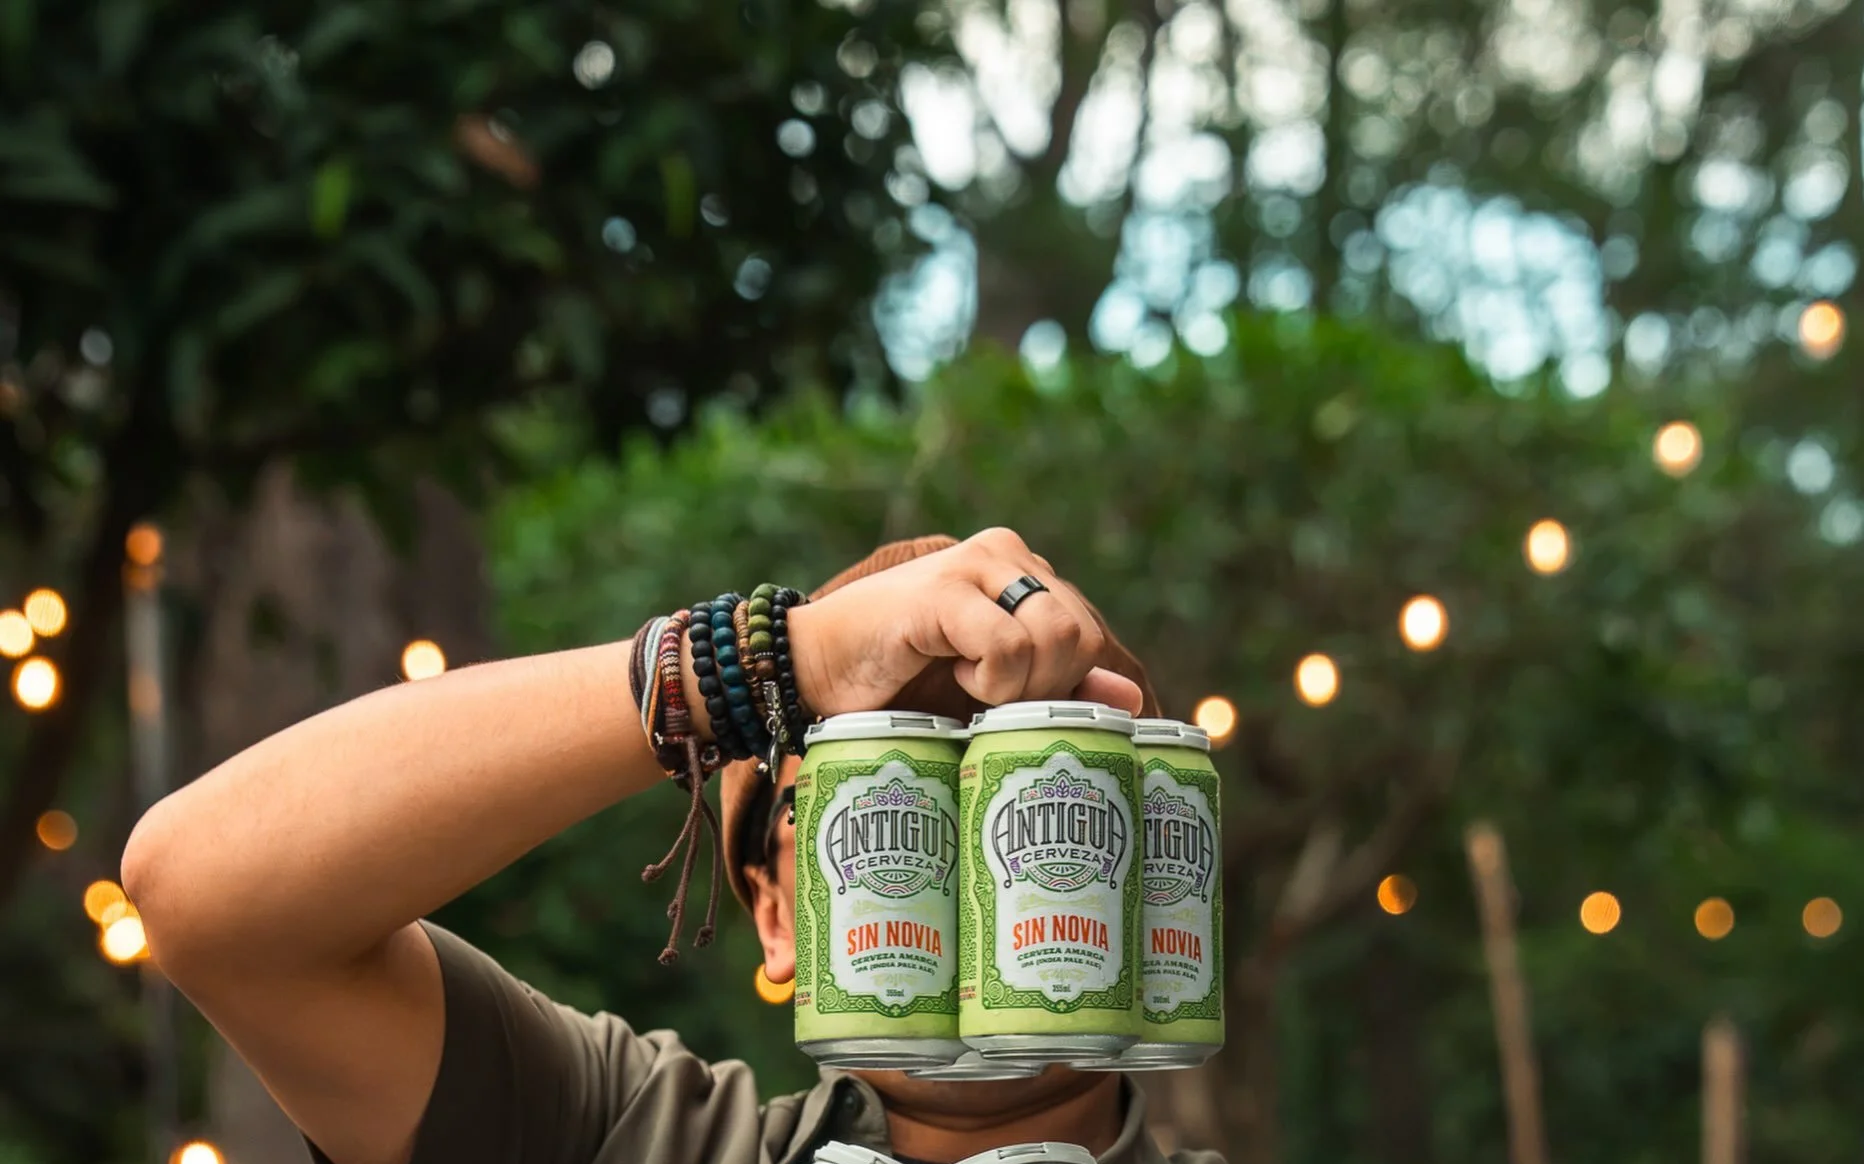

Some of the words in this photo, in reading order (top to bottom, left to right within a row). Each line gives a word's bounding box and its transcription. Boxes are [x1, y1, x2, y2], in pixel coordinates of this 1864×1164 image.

[826, 806, 959, 896] ANTIGUA
[992, 799, 1127, 890] ANTIGUA
[1021, 848, 1101, 865] CERVEZA
[855, 855, 935, 871] CERVEZA
[1144, 863, 1195, 880] RVEZA
[847, 922, 880, 956] SIN
[885, 921, 943, 957] NOVIA
[1013, 916, 1045, 951] SIN
[1051, 915, 1110, 952] NOVIA
[1151, 927, 1202, 964] NOVIA
[851, 952, 895, 967] CERVEZA
[899, 953, 939, 968] AMARGA
[1017, 947, 1062, 962] CERVEZA
[1065, 948, 1105, 962] AMARGA
